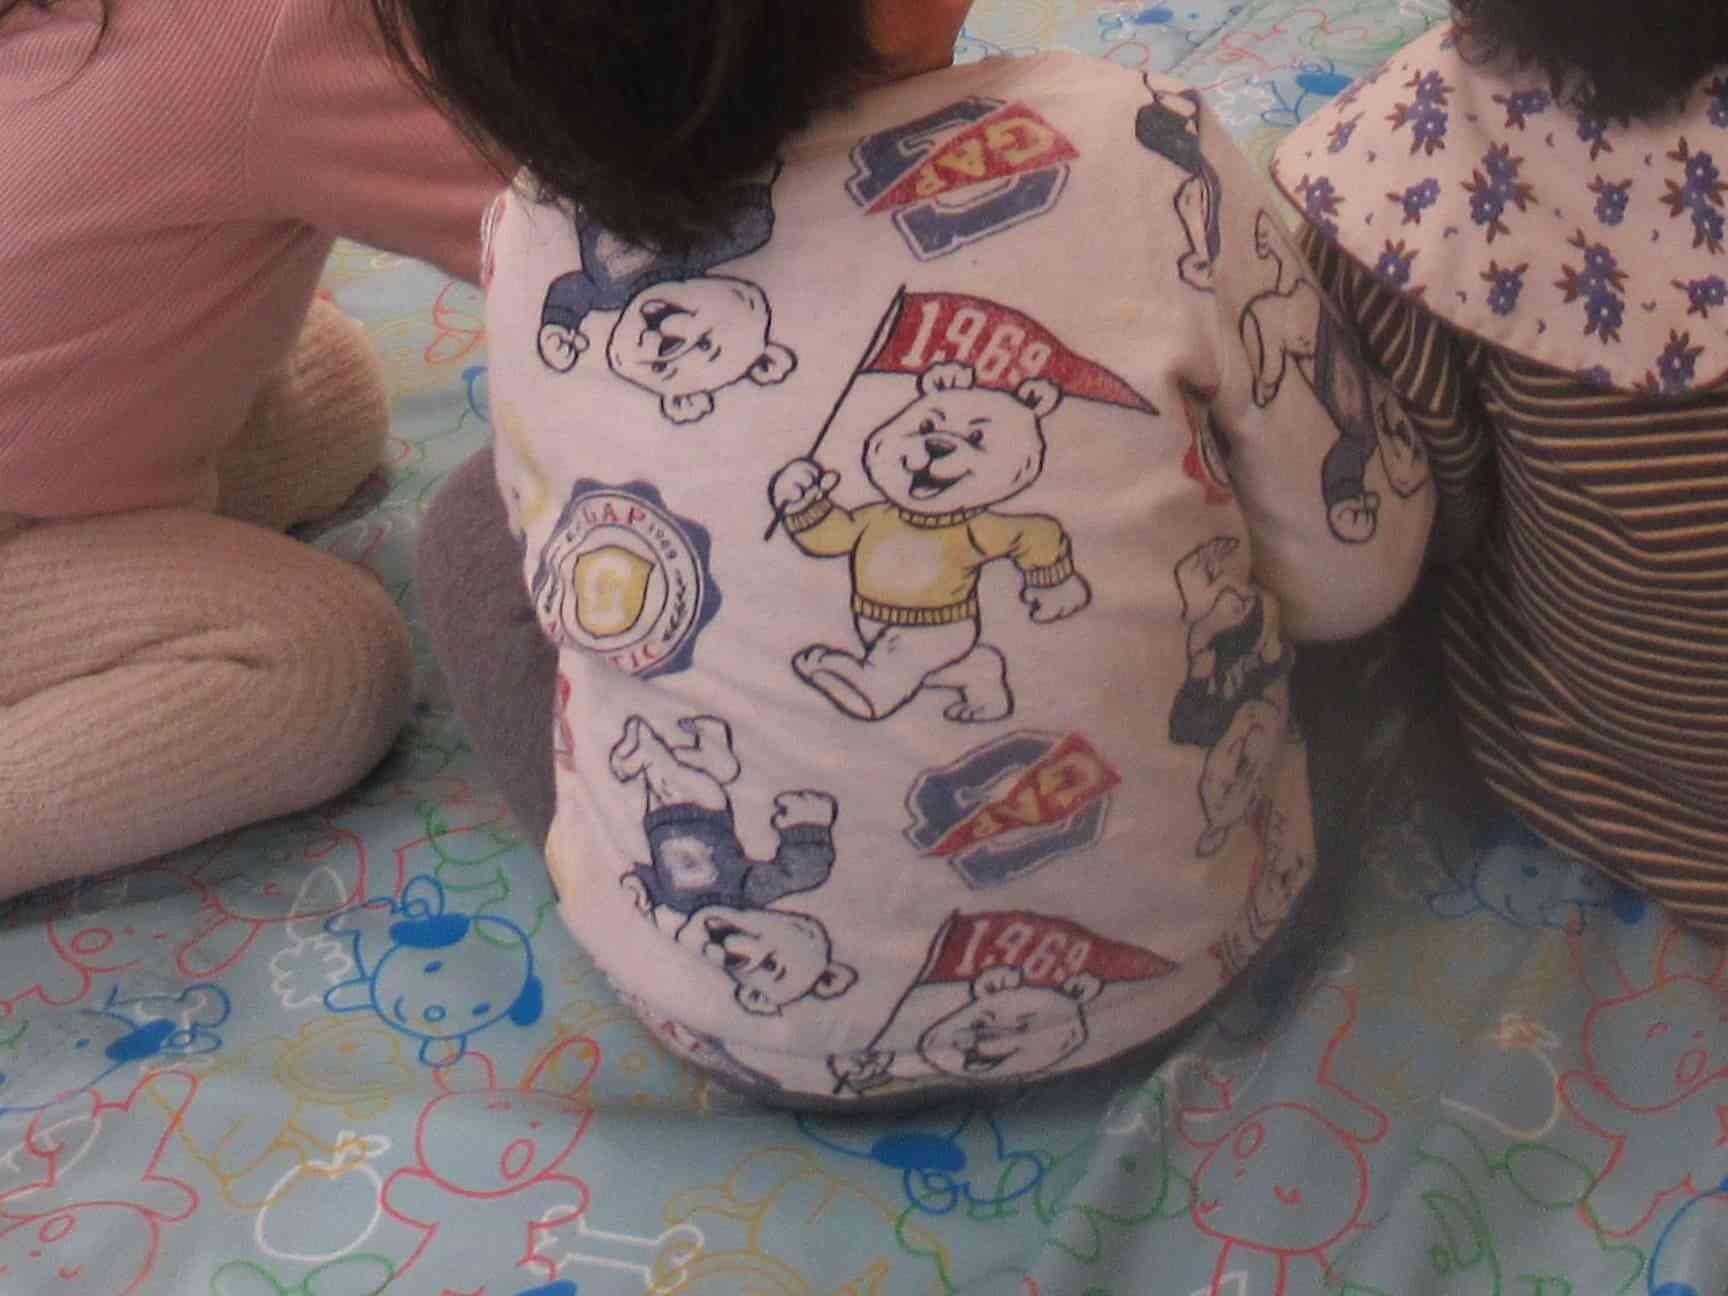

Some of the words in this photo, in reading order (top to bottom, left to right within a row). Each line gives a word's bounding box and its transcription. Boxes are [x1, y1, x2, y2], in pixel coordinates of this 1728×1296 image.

[914, 116, 1057, 196] GAP
[900, 300, 1051, 387] 1969
[582, 502, 646, 526] GAP
[973, 750, 1104, 840] GAP
[954, 919, 1092, 984] 1969
